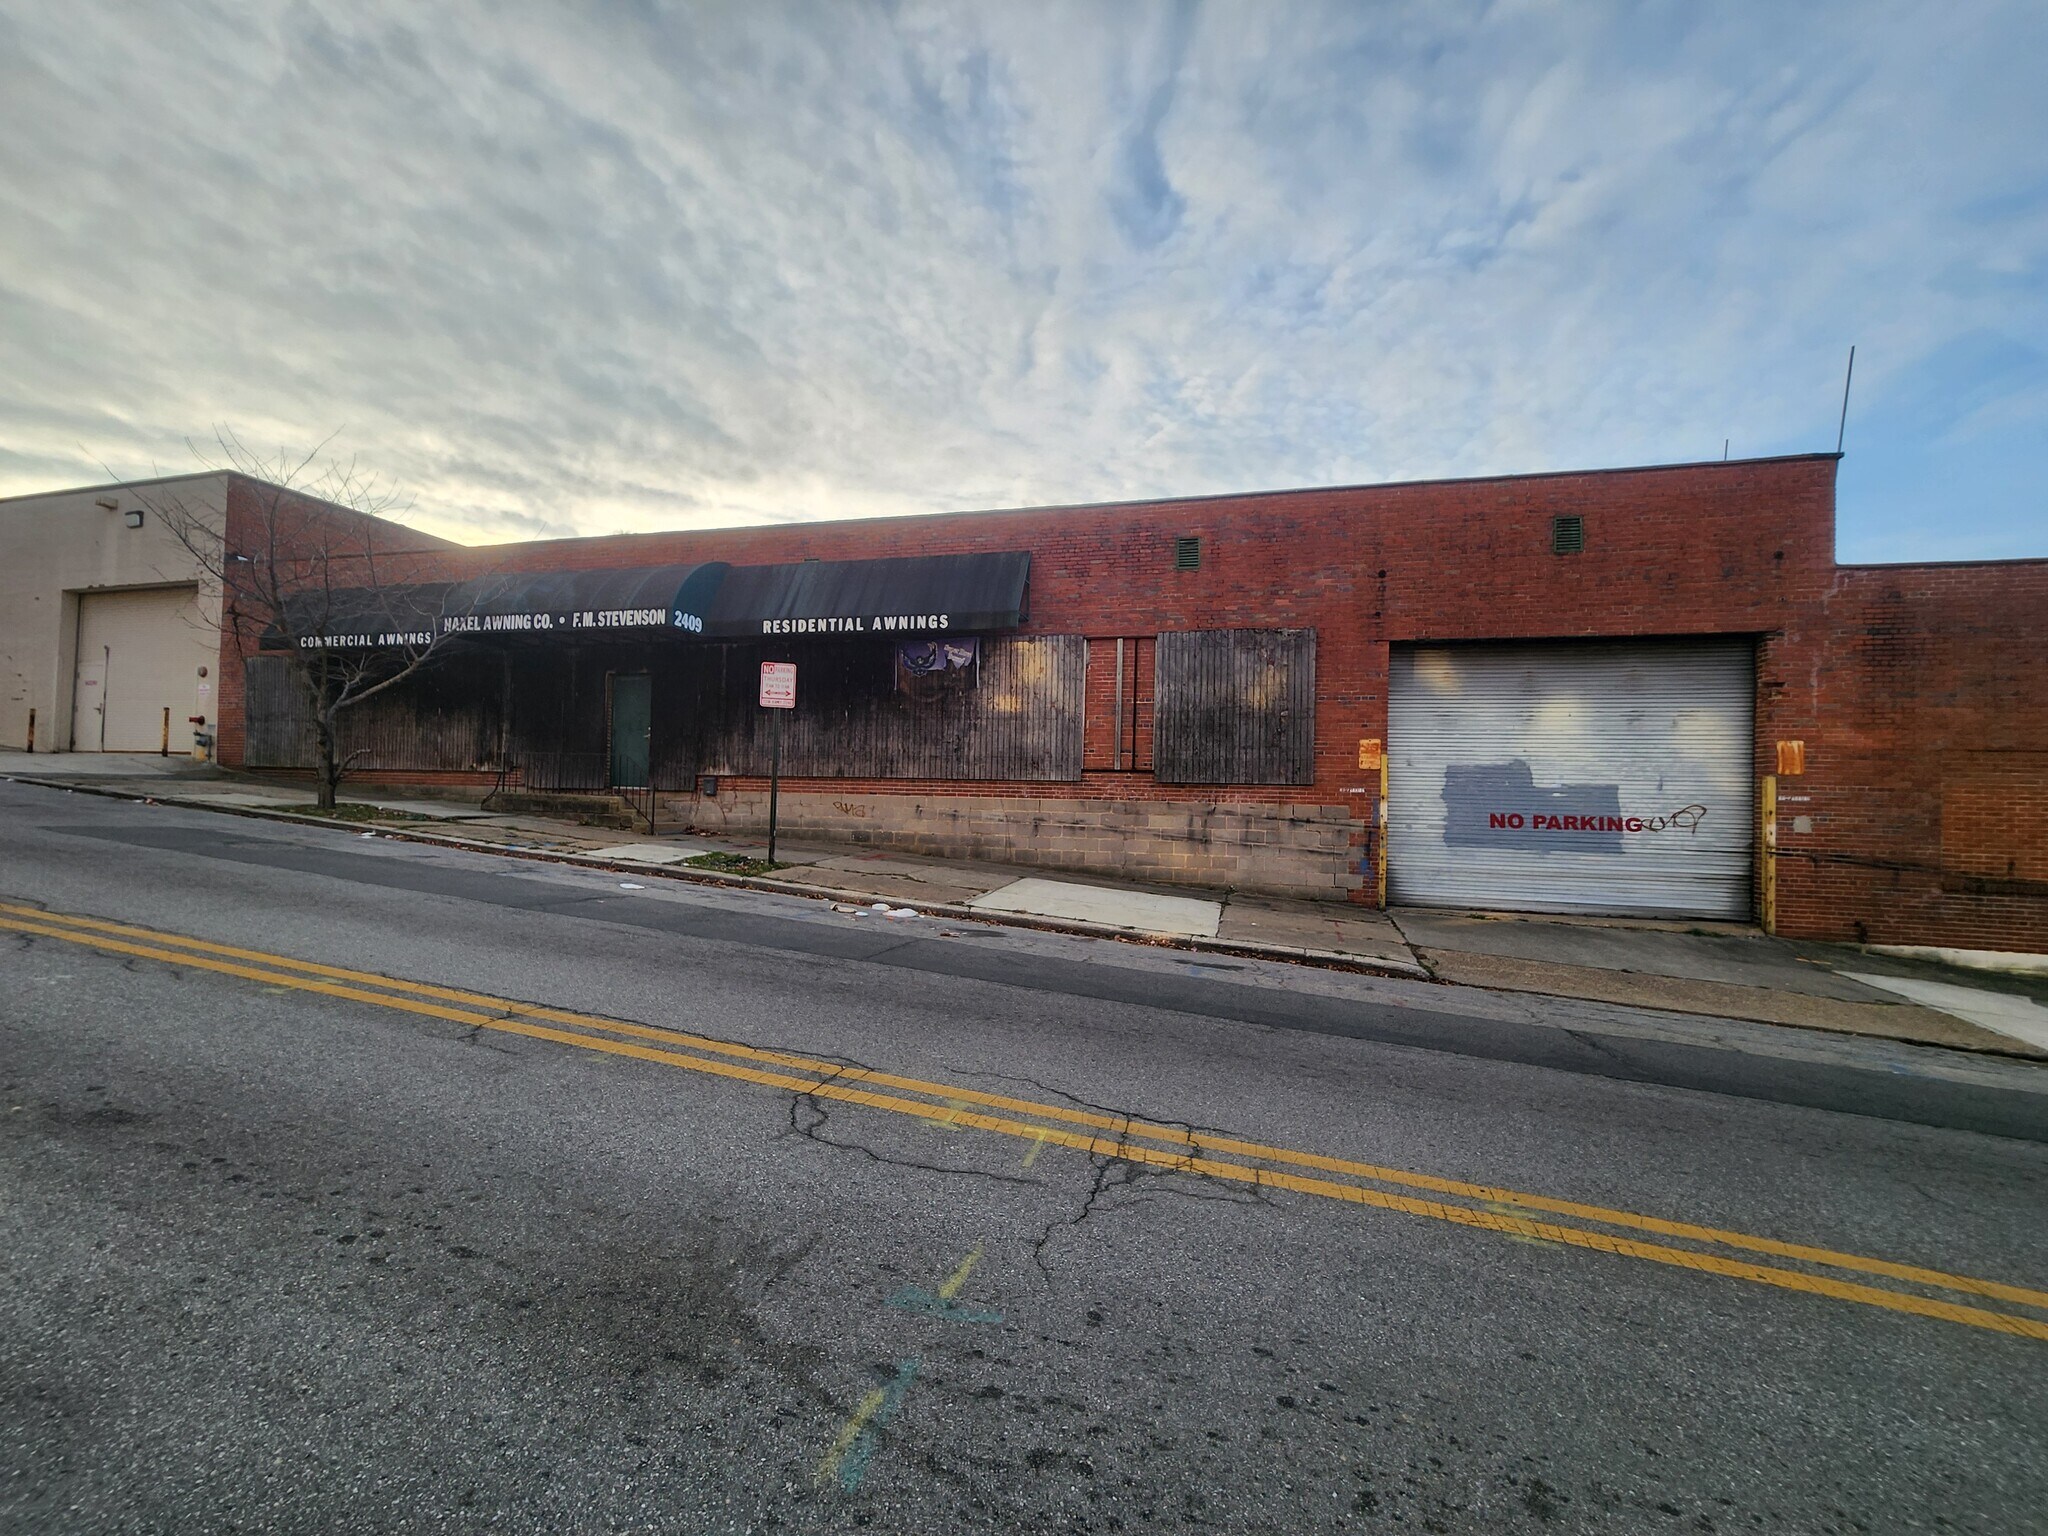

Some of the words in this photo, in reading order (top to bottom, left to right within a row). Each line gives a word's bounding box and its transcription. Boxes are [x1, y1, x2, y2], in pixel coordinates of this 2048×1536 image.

[483, 613, 531, 631] AWNING
[533, 612, 553, 630] CO.
[598, 608, 666, 627] STEVENSON
[674, 610, 703, 633] 2409
[762, 617, 864, 634] RESIDENTIAL
[872, 614, 949, 631] AWNINGS
[300, 633, 373, 648] COMMERCIAL
[378, 631, 431, 646] AWNINGS
[763, 664, 774, 674] NO
[1489, 813, 1525, 829] NO
[1532, 815, 1643, 833] PARKING
